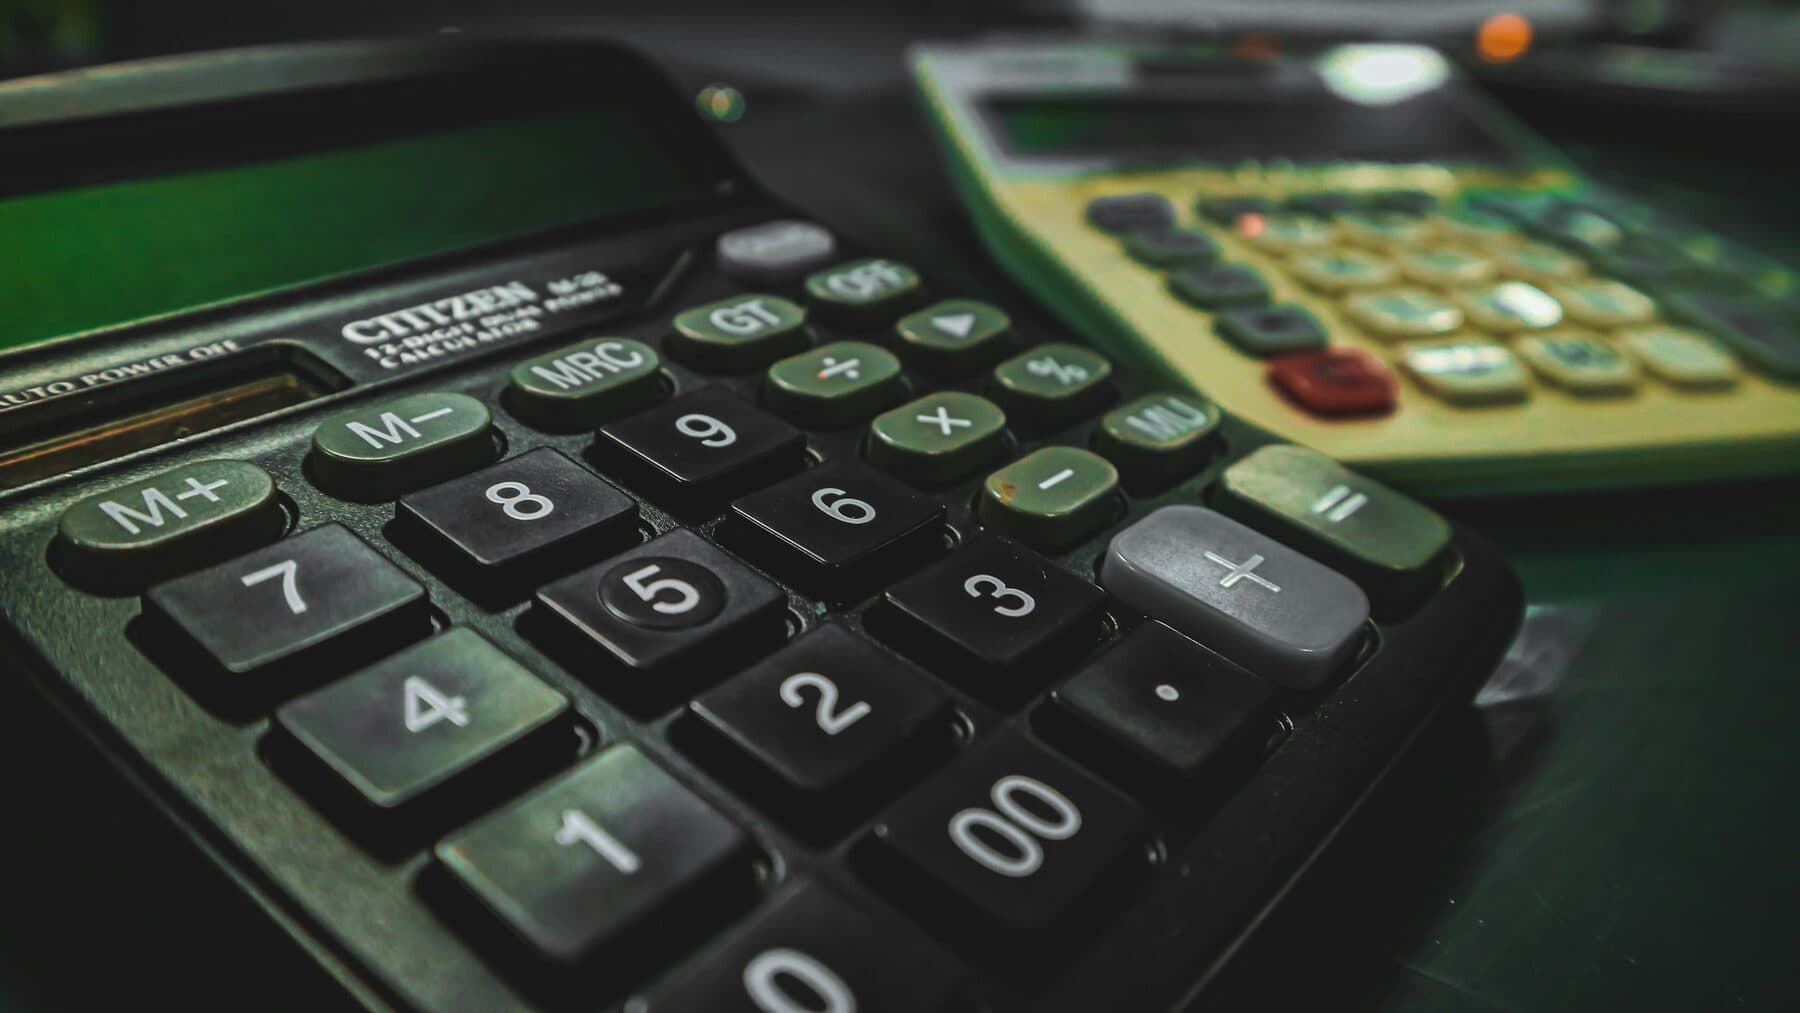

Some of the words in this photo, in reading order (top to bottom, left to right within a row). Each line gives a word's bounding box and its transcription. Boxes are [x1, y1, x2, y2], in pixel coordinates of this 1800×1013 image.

[341, 279, 540, 344] CITIZEN
[709, 300, 781, 336] GT
[80, 352, 183, 386] POWER
[188, 338, 240, 362] OFF
[531, 341, 644, 391] MRC
[675, 413, 738, 448] 9
[1125, 398, 1206, 440] MU
[98, 475, 229, 535] M+
[484, 480, 556, 522] 8
[810, 487, 877, 526] 6
[240, 558, 309, 616] 7
[621, 564, 700, 615] 5
[963, 573, 1037, 619] 3
[403, 675, 471, 735] 4
[778, 672, 872, 736] 2
[554, 808, 640, 874] 1
[947, 774, 1083, 878] 00
[743, 947, 857, 1013] 0
